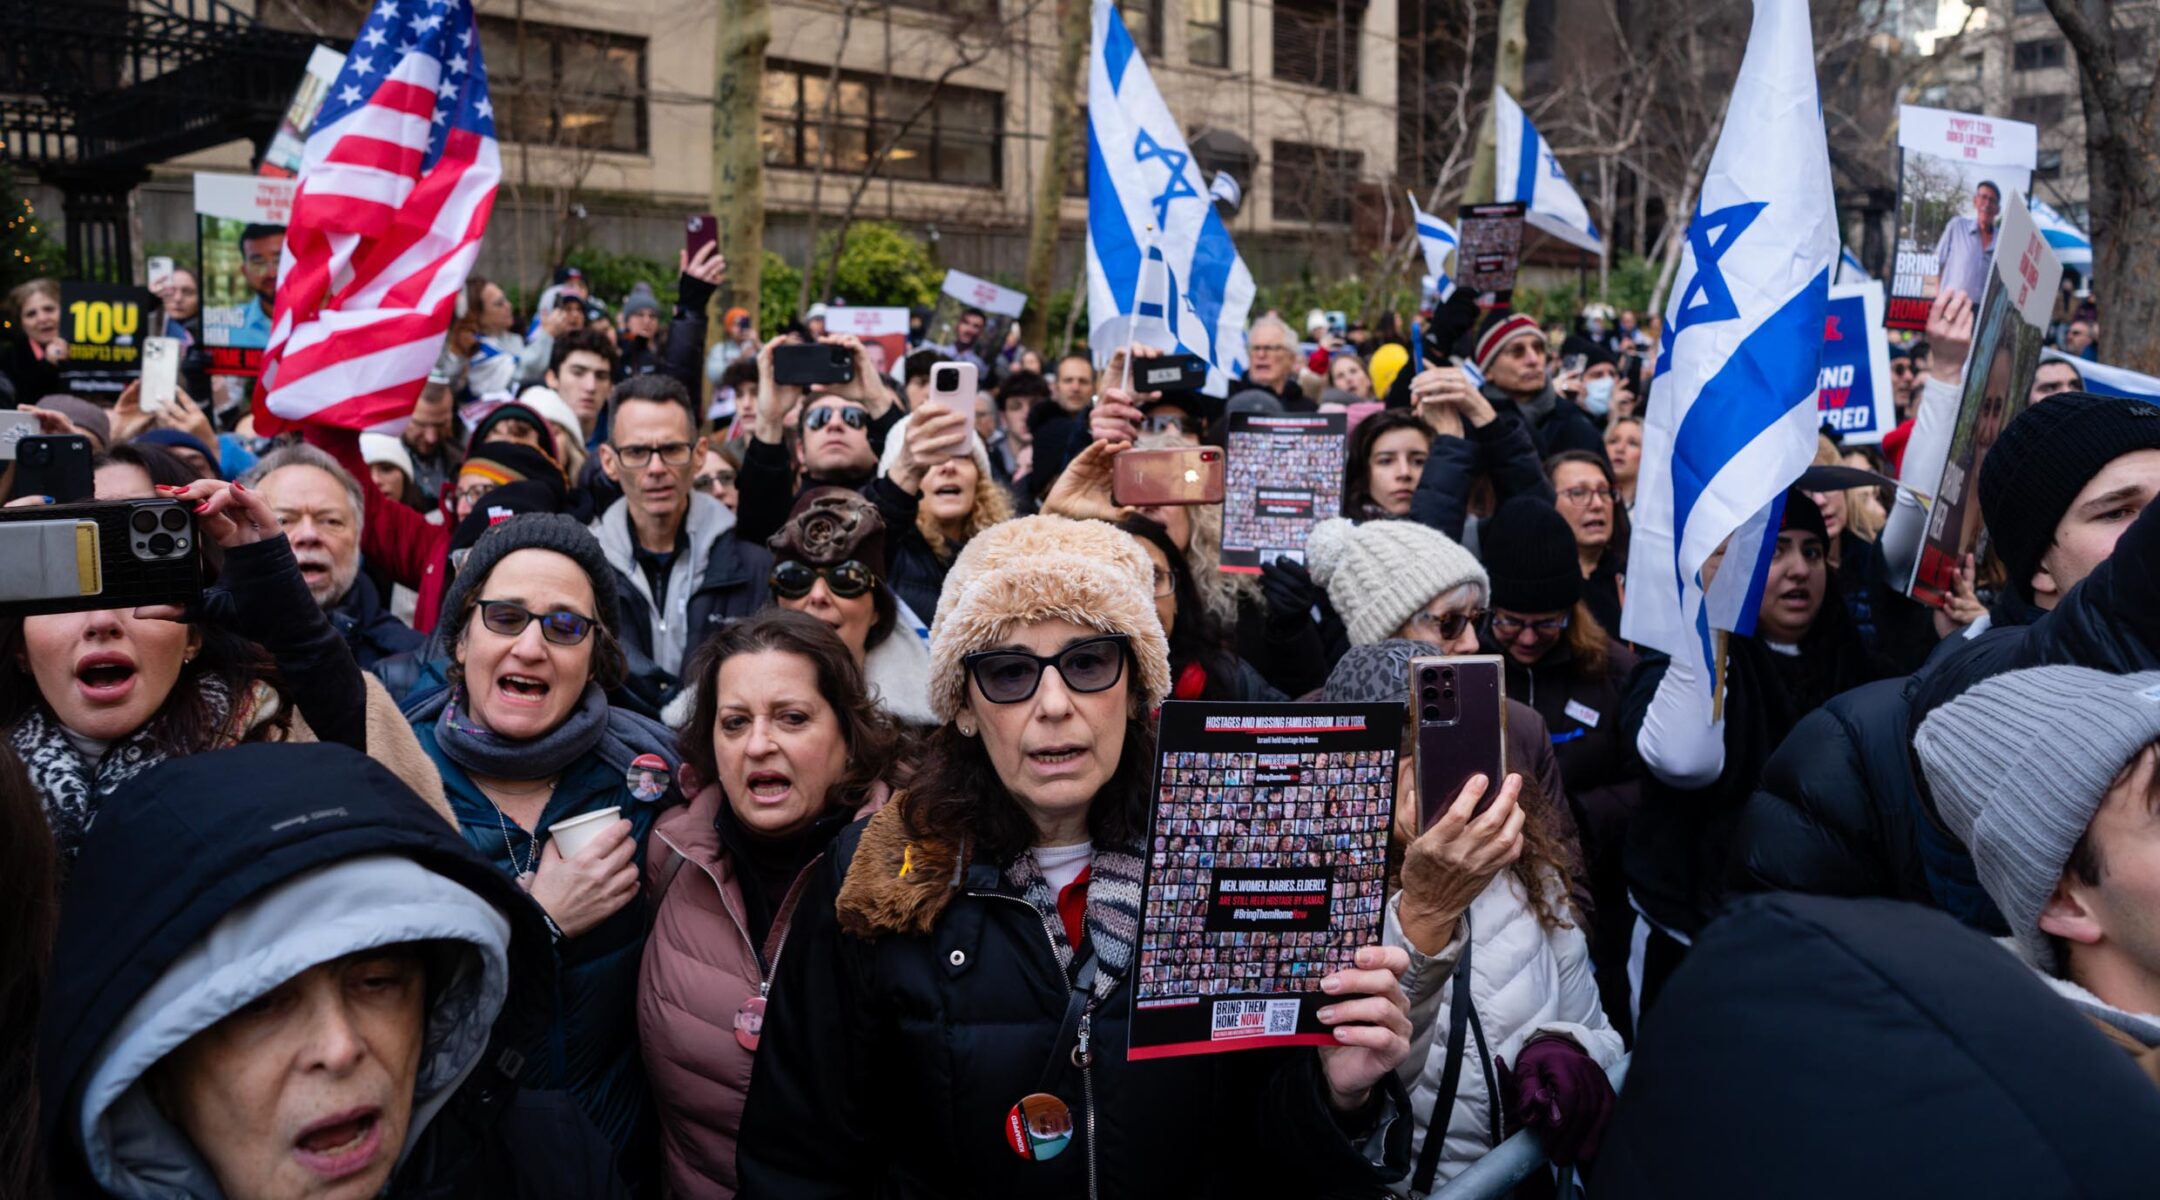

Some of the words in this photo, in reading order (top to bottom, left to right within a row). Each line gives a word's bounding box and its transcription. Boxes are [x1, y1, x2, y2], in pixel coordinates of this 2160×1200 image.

[1895, 252, 1939, 276] BRING
[1891, 274, 1922, 298] HIM
[1205, 716, 1241, 729] HOSTAGES
[1241, 716, 1256, 729] AND
[1256, 716, 1286, 729] MISSING
[1285, 716, 1313, 729] FAMILIES
[1313, 716, 1334, 728] FORUM
[1335, 716, 1350, 727] NEW
[1350, 715, 1366, 727] YORK
[1232, 896, 1248, 905] STILL
[1233, 909, 1308, 921] #BringThemHomeNow
[1216, 1001, 1241, 1015] BRING
[1243, 1000, 1266, 1013] THEM
[1215, 1014, 1239, 1028] HOME
[1240, 1012, 1264, 1026] NOW!
[1011, 1115, 1025, 1153] KIDNAPPED
